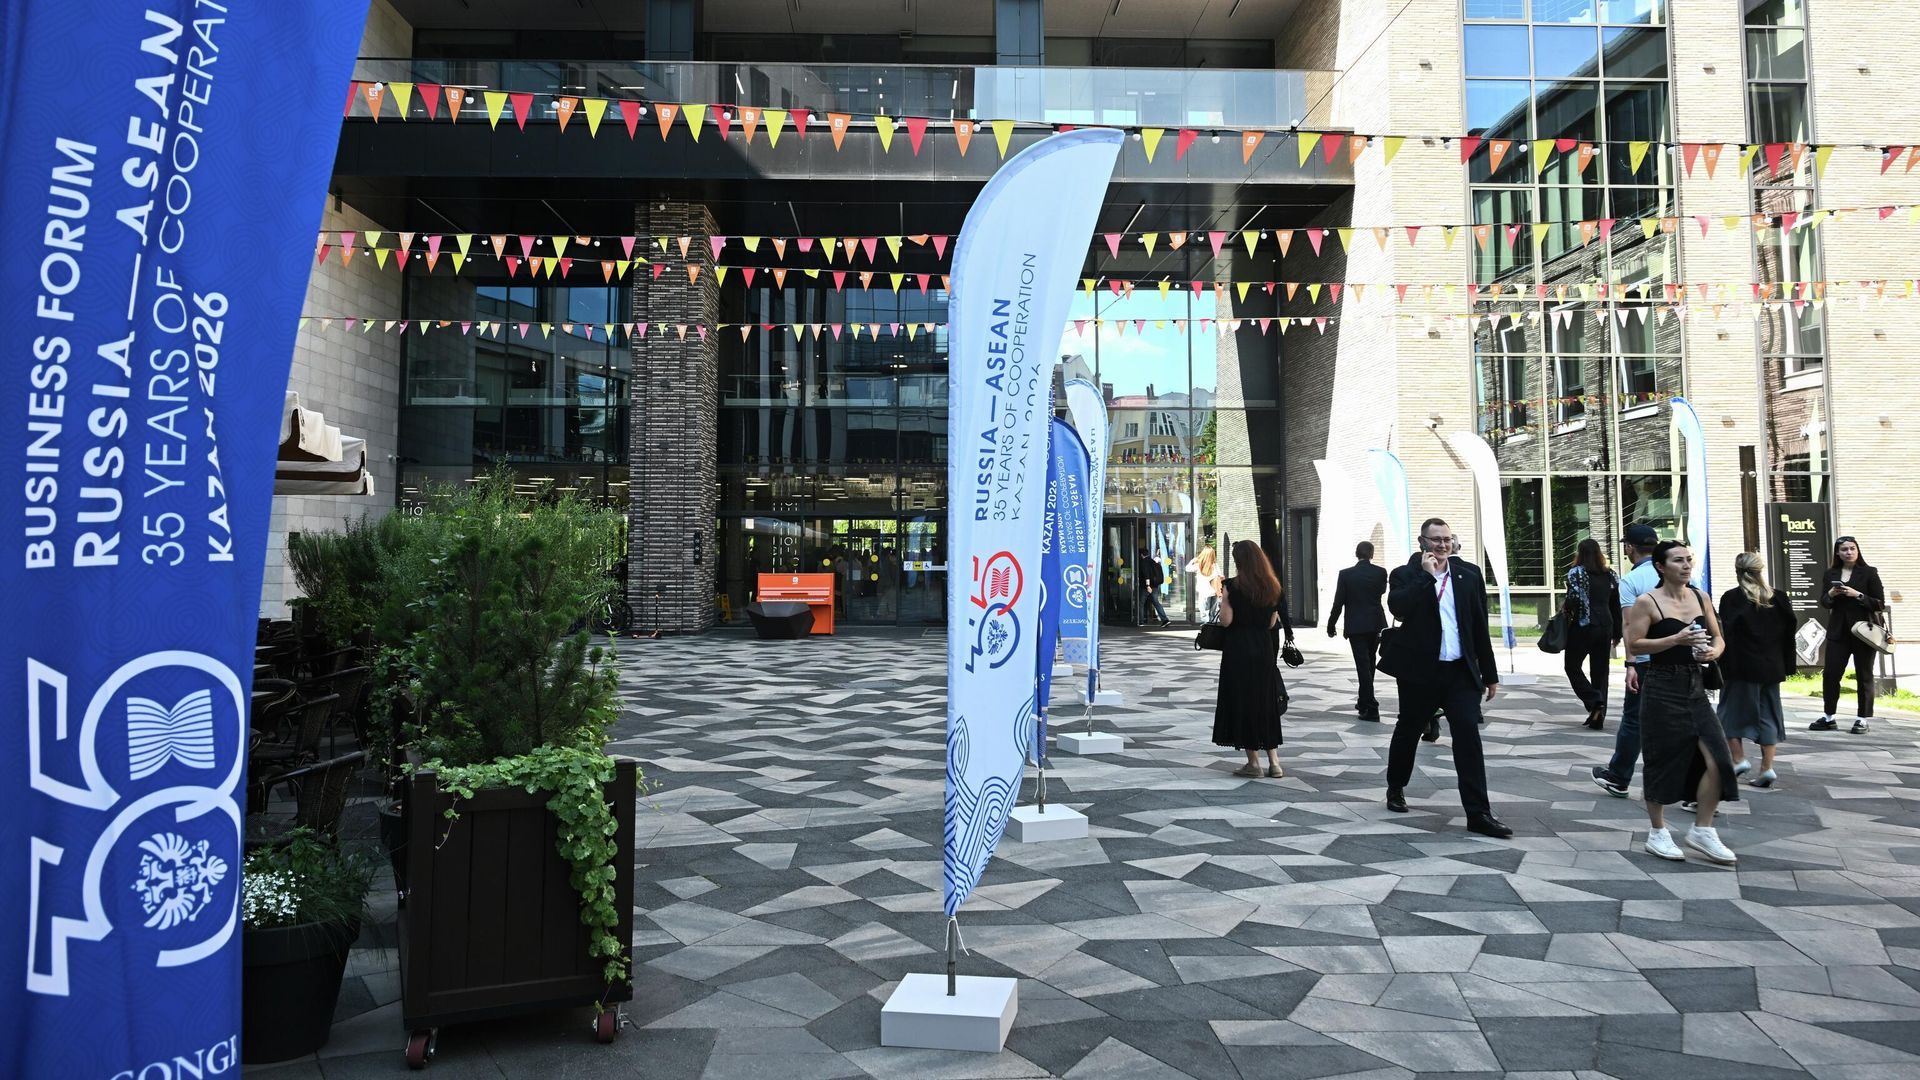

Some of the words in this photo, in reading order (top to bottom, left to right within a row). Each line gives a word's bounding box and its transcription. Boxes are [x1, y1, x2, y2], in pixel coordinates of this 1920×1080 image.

[37, 138, 96, 321] FORUM
[153, 266, 187, 333] OF
[1008, 253, 1037, 397] COOPERATION
[192, 293, 228, 396] 2026
[144, 349, 189, 497] YEARS
[1004, 402, 1017, 429] OF
[25, 336, 70, 568] BUSINESS
[995, 434, 1015, 495] YEARS
[992, 500, 1007, 521] 35
[1047, 480, 1057, 509] 2026
[1787, 518, 1816, 532] park
[142, 513, 184, 566] 35
[1042, 512, 1055, 554] KAZAN
